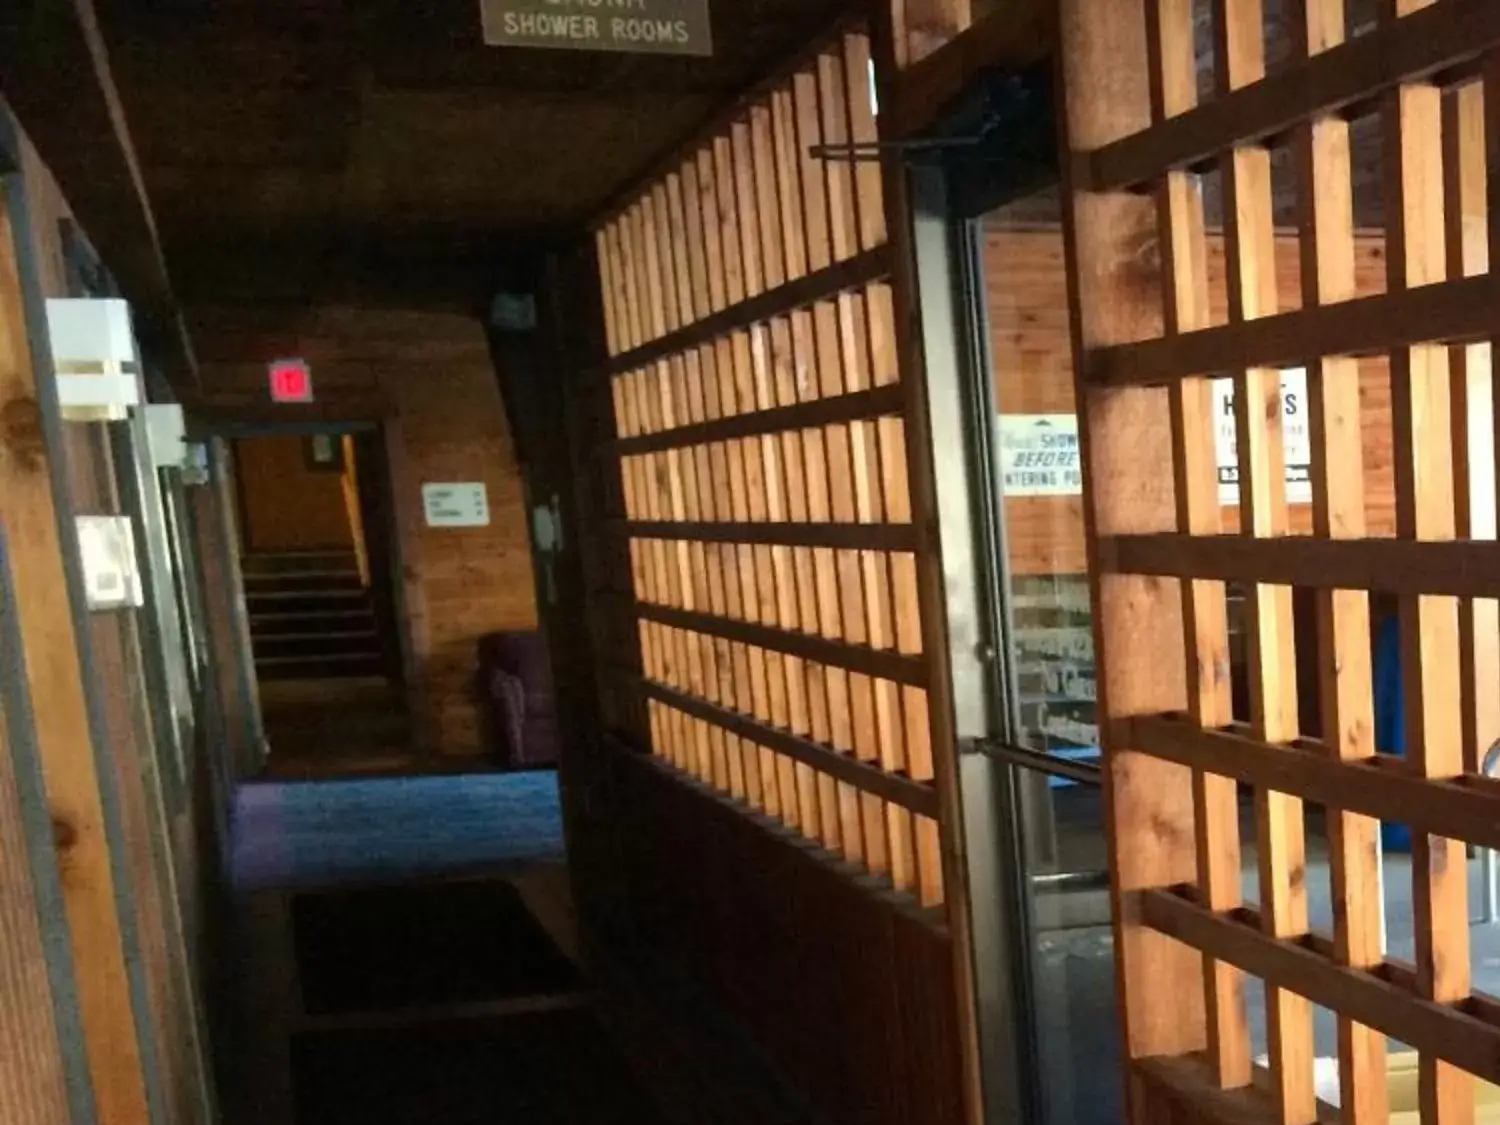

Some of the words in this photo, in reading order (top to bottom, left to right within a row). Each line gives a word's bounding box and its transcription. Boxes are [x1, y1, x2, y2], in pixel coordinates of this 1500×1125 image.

[503, 12, 599, 38] SHOWER
[612, 17, 689, 42] ROOMS
[1013, 451, 1076, 467] BEFORE
